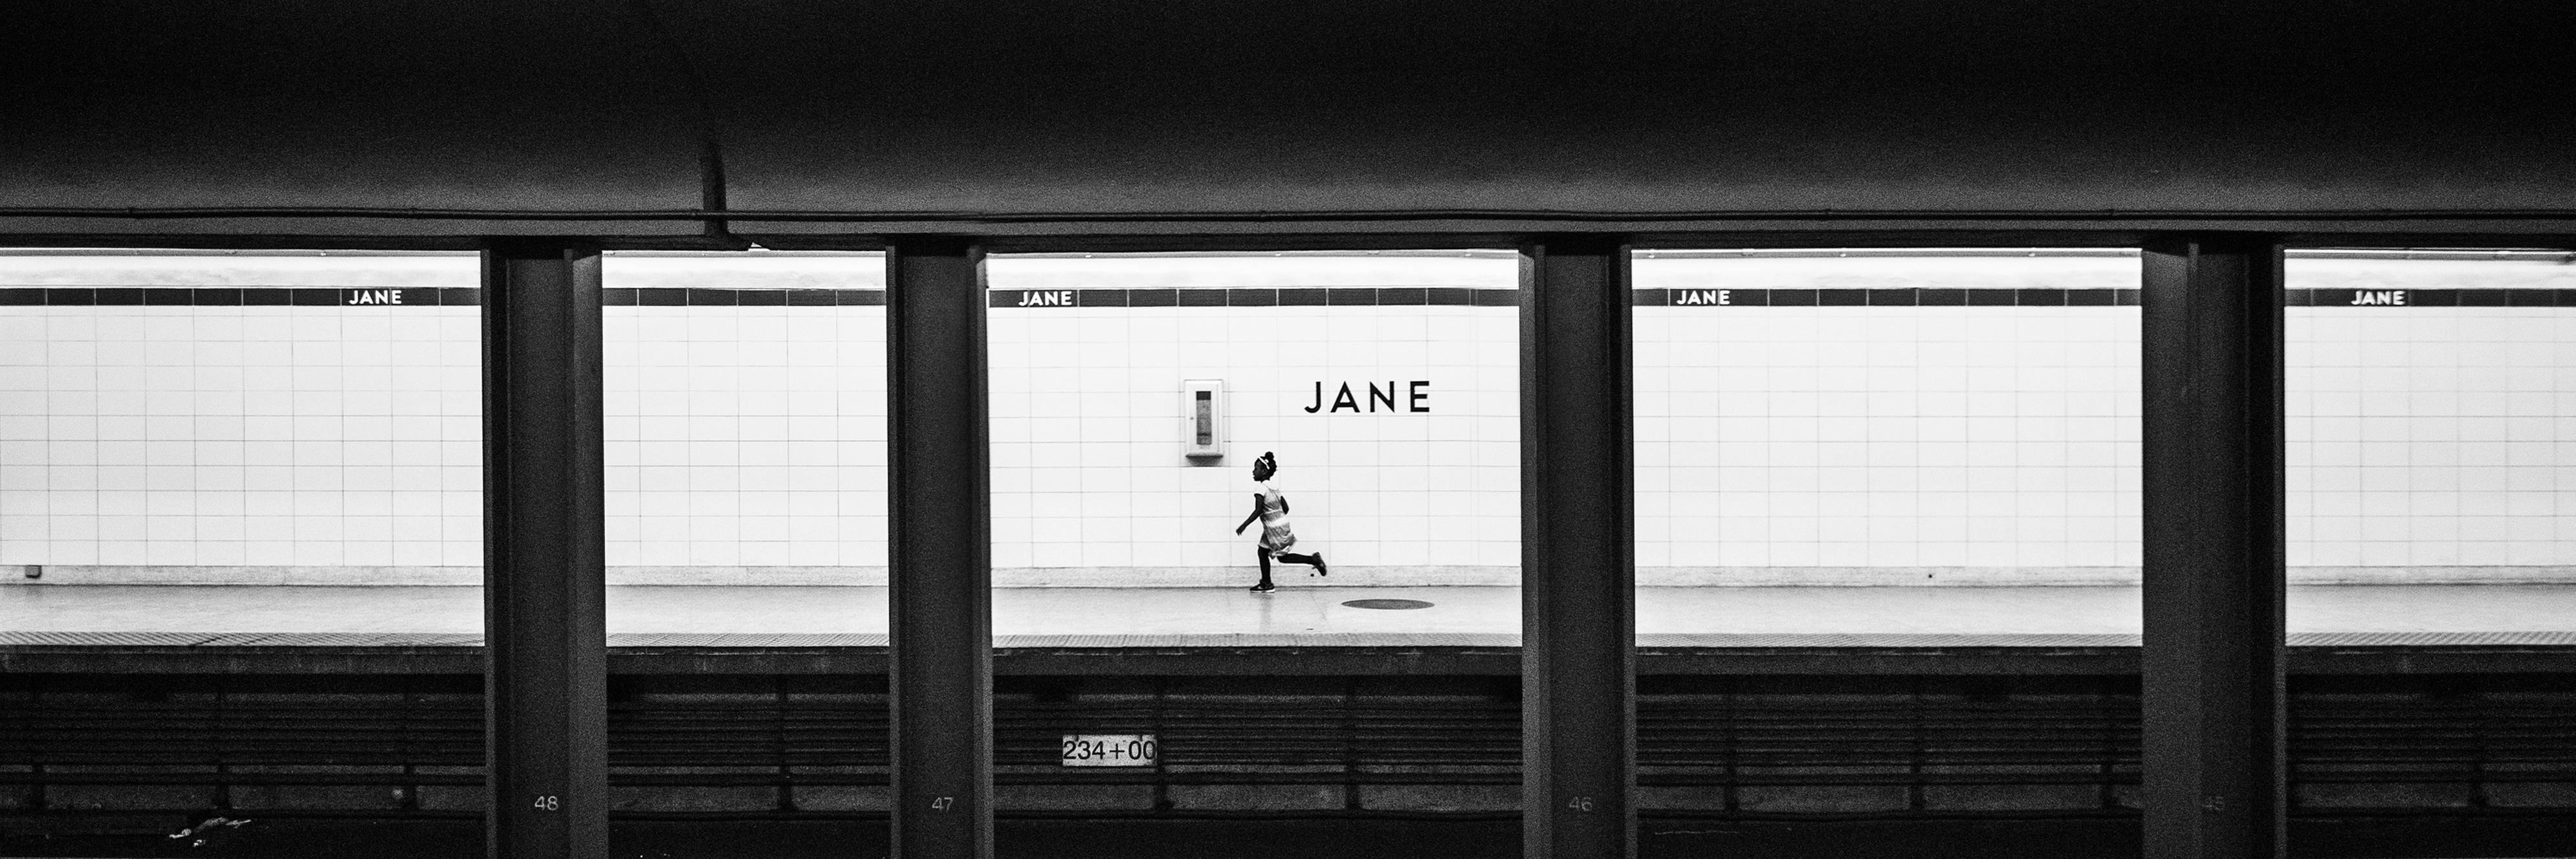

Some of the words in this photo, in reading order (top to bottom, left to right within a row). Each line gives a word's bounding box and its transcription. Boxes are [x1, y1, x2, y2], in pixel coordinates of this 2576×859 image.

[349, 290, 402, 305] JANE
[1018, 291, 1072, 307] JANE
[1676, 290, 1730, 305] JANE
[2350, 290, 2405, 305] JANE
[1304, 380, 1431, 414] JANE
[1063, 740, 1156, 760] 234+00
[534, 796, 558, 810] 48
[932, 797, 953, 812] 47
[1568, 796, 1593, 811] 46
